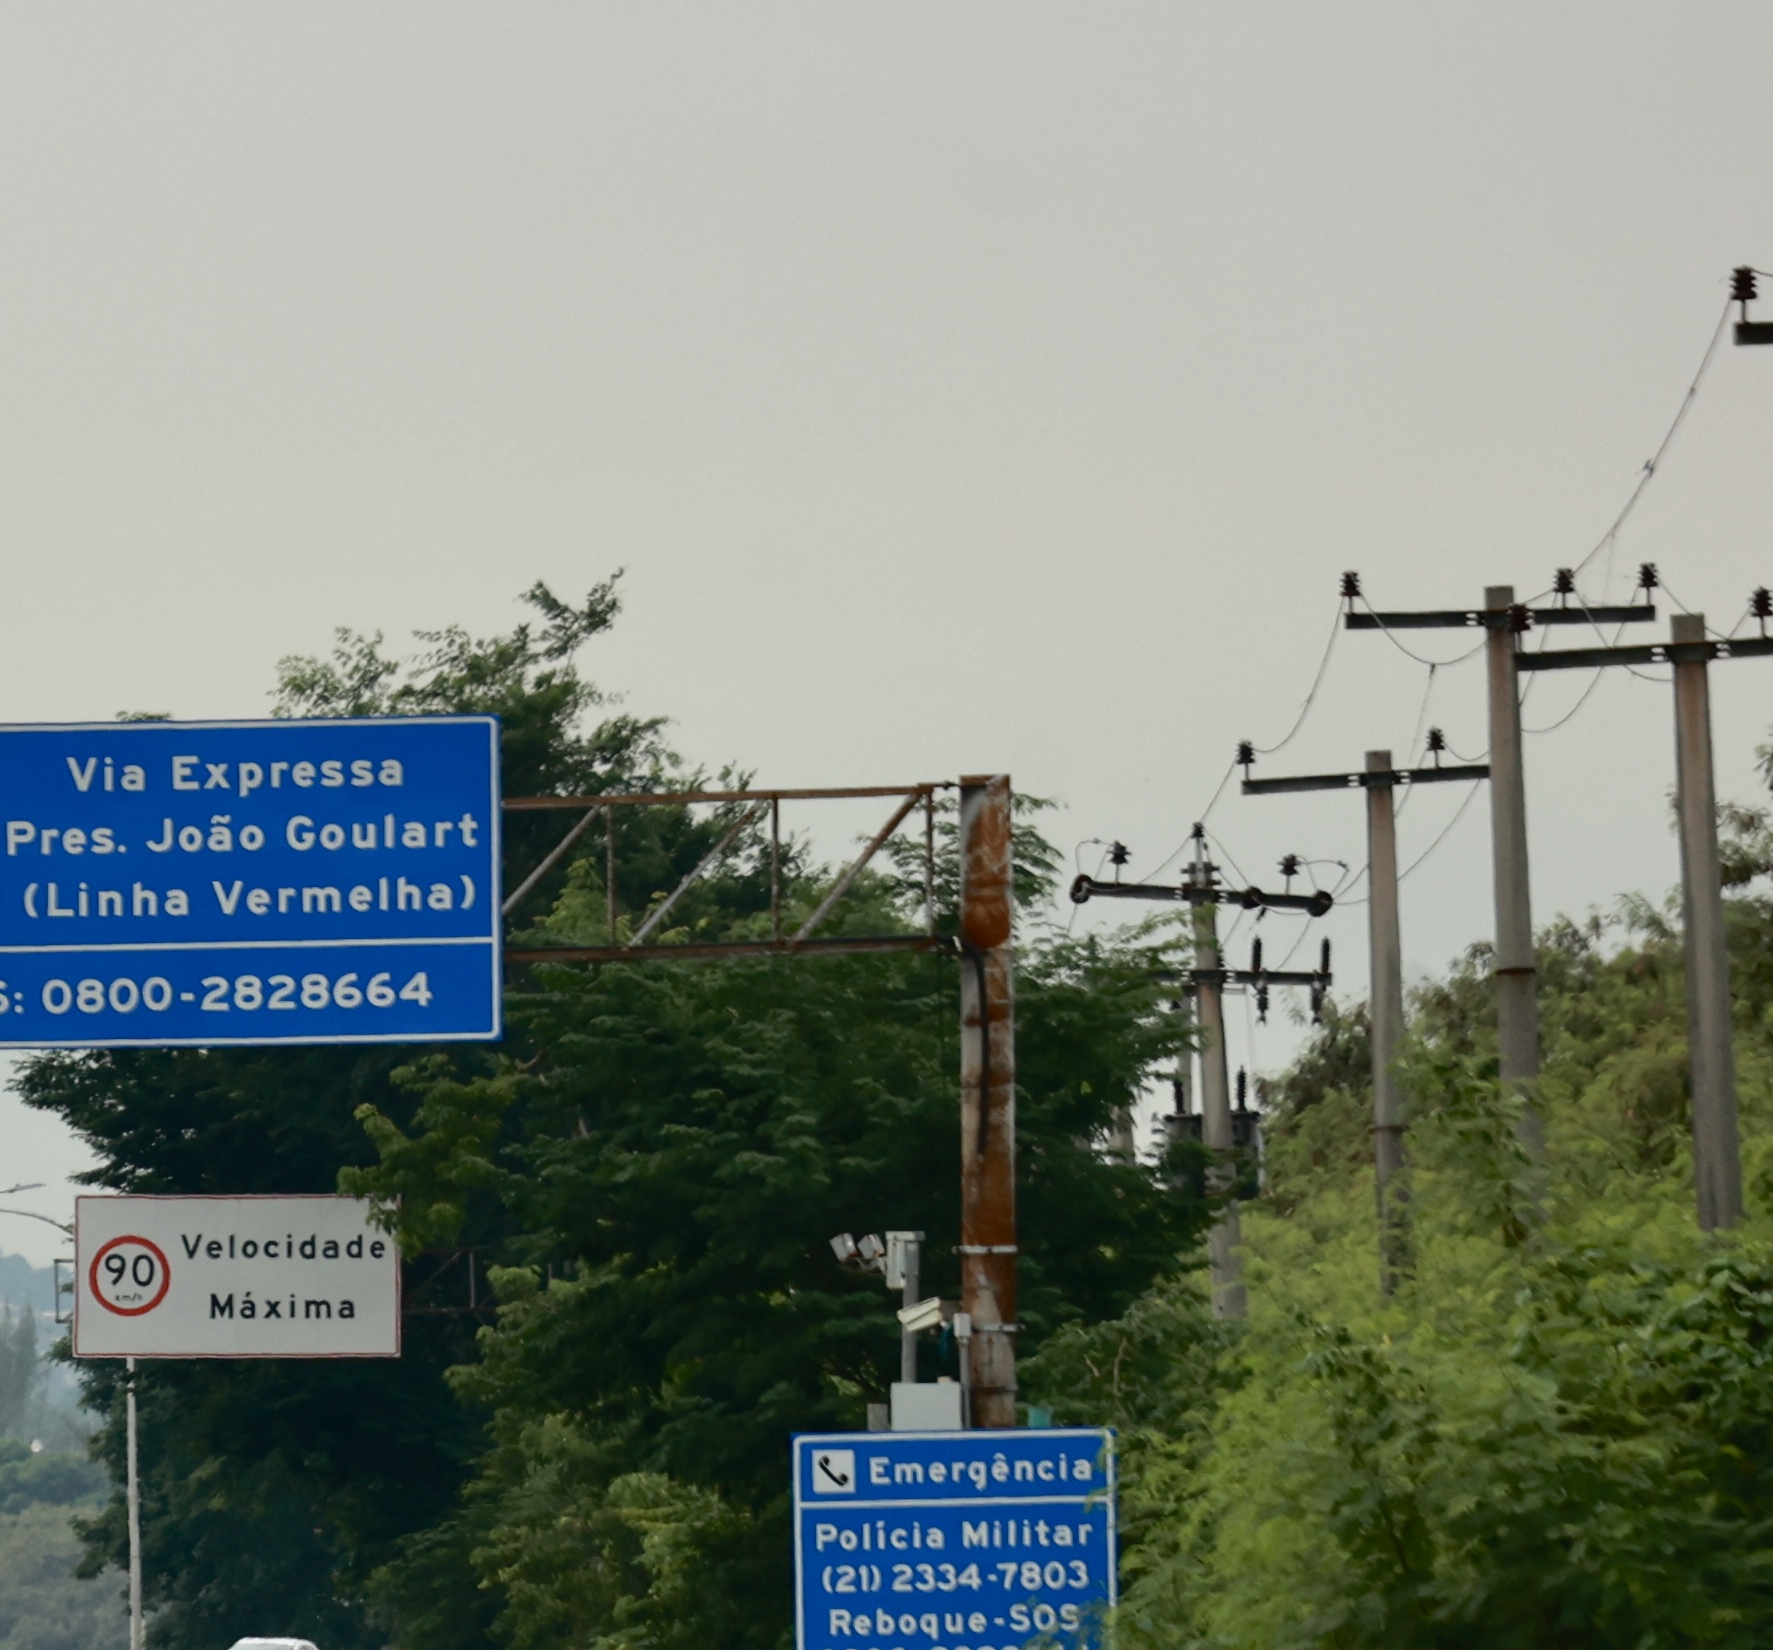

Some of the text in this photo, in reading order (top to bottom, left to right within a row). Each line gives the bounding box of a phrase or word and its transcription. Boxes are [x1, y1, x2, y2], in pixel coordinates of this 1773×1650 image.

[66, 755, 404, 798] Via Expressa
[6, 812, 479, 857] Pres. João Goulart
[23, 874, 476, 918] (Linha Vermelha)
[41, 971, 433, 1015] 0800-2828664
[105, 1233, 387, 1287] 90 Velocidade
[209, 1290, 356, 1320] Máxima
[869, 1452, 1093, 1492] Emergência
[815, 1518, 1093, 1552] Polícia Militar
[821, 1559, 1089, 1594] (21) 2334-7803
[829, 1603, 1081, 1641] Reboque-SOS
